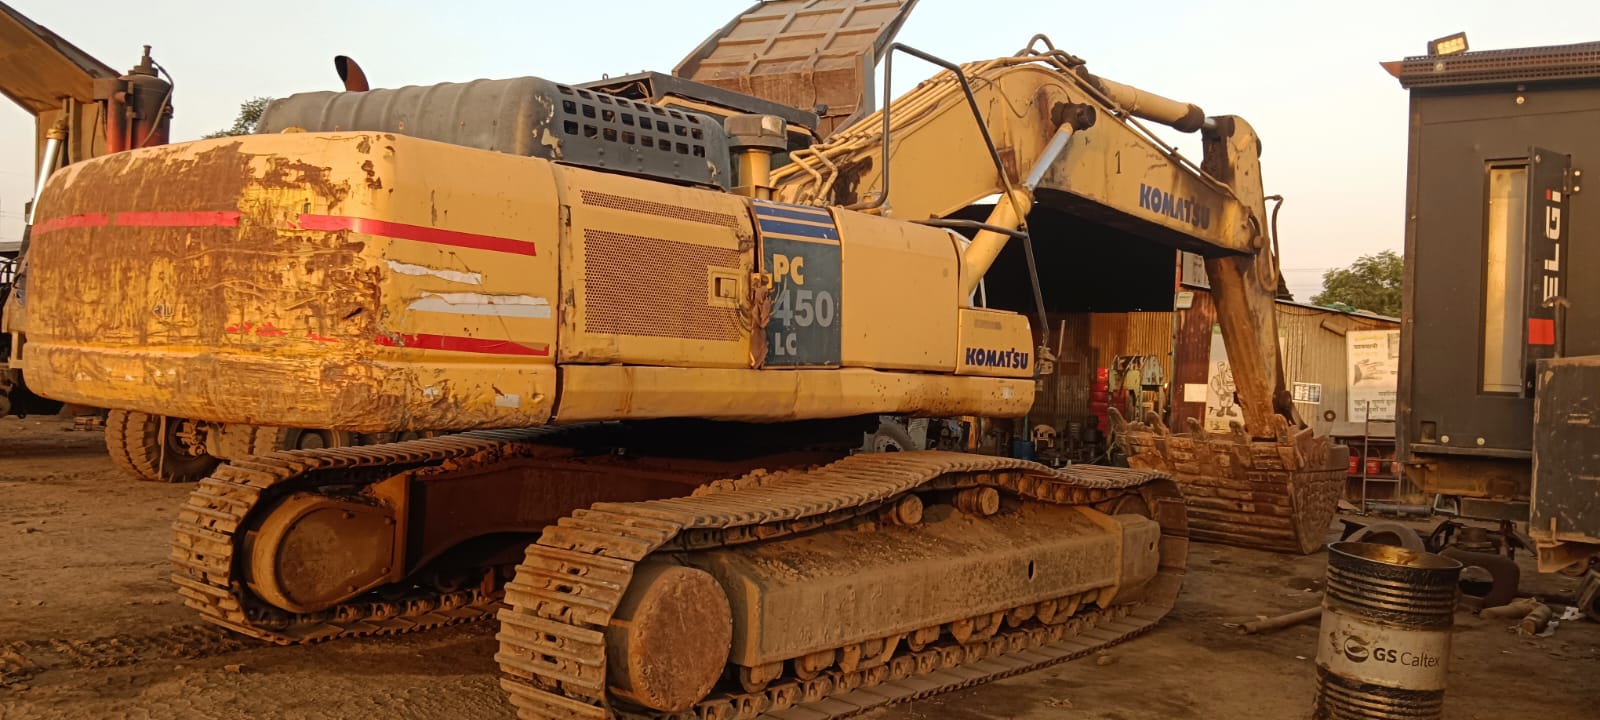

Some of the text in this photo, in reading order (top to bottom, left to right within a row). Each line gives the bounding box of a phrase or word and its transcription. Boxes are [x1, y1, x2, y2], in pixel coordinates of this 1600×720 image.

[1139, 183, 1210, 230] KOMATSU
[773, 253, 804, 285] PC
[774, 289, 834, 327] 450
[775, 332, 796, 356] LC
[965, 347, 1029, 370] KOMATSU
[1373, 647, 1440, 668] GS Caltex
